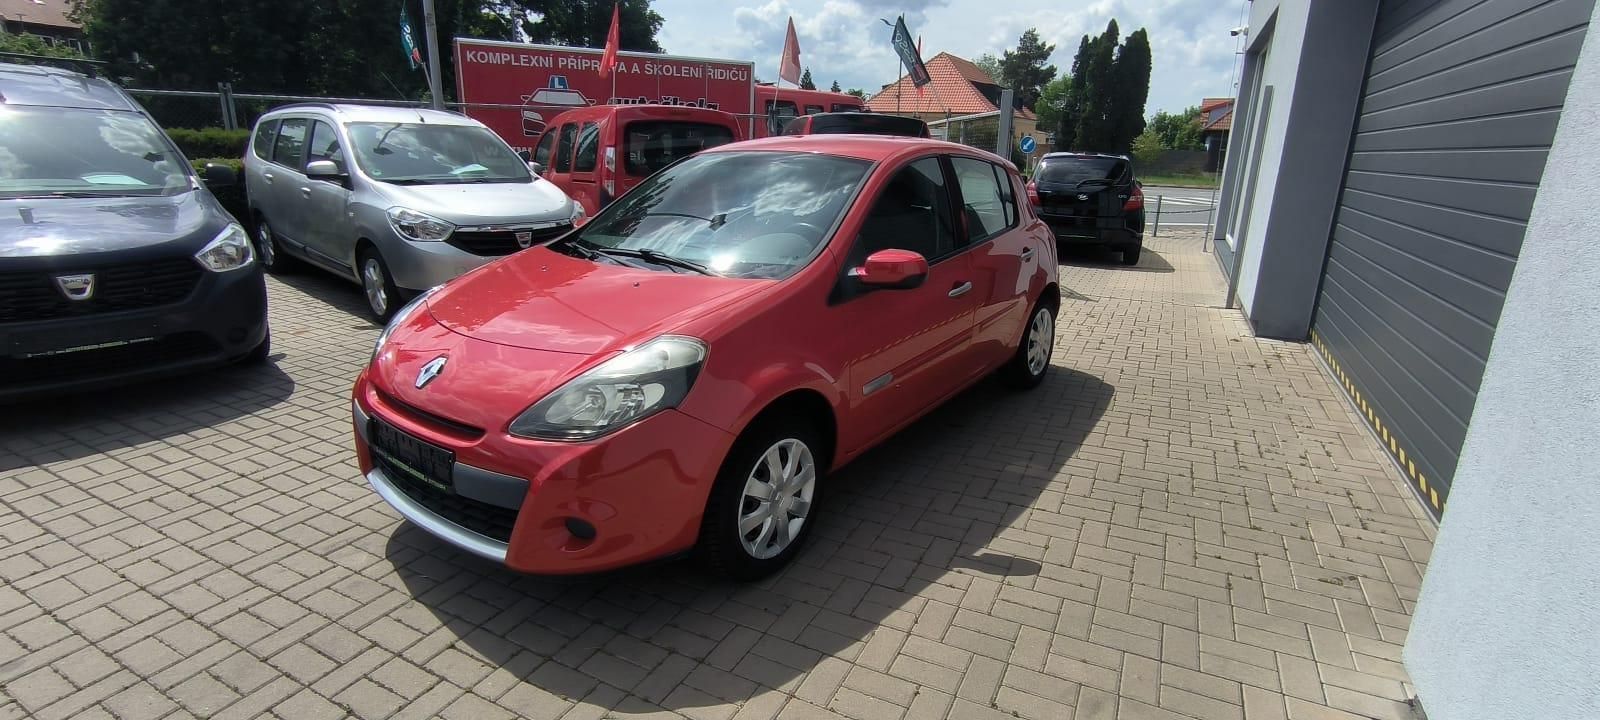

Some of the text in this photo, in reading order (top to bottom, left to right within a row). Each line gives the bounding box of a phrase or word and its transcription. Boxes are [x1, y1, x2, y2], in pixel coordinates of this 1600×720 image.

[466, 50, 553, 68] KOMPLEXNÍ
[558, 55, 627, 73] PŘÍPRVA
[631, 62, 641, 74] A
[644, 60, 703, 78] ŠKOLENÍ
[554, 77, 564, 89] L
